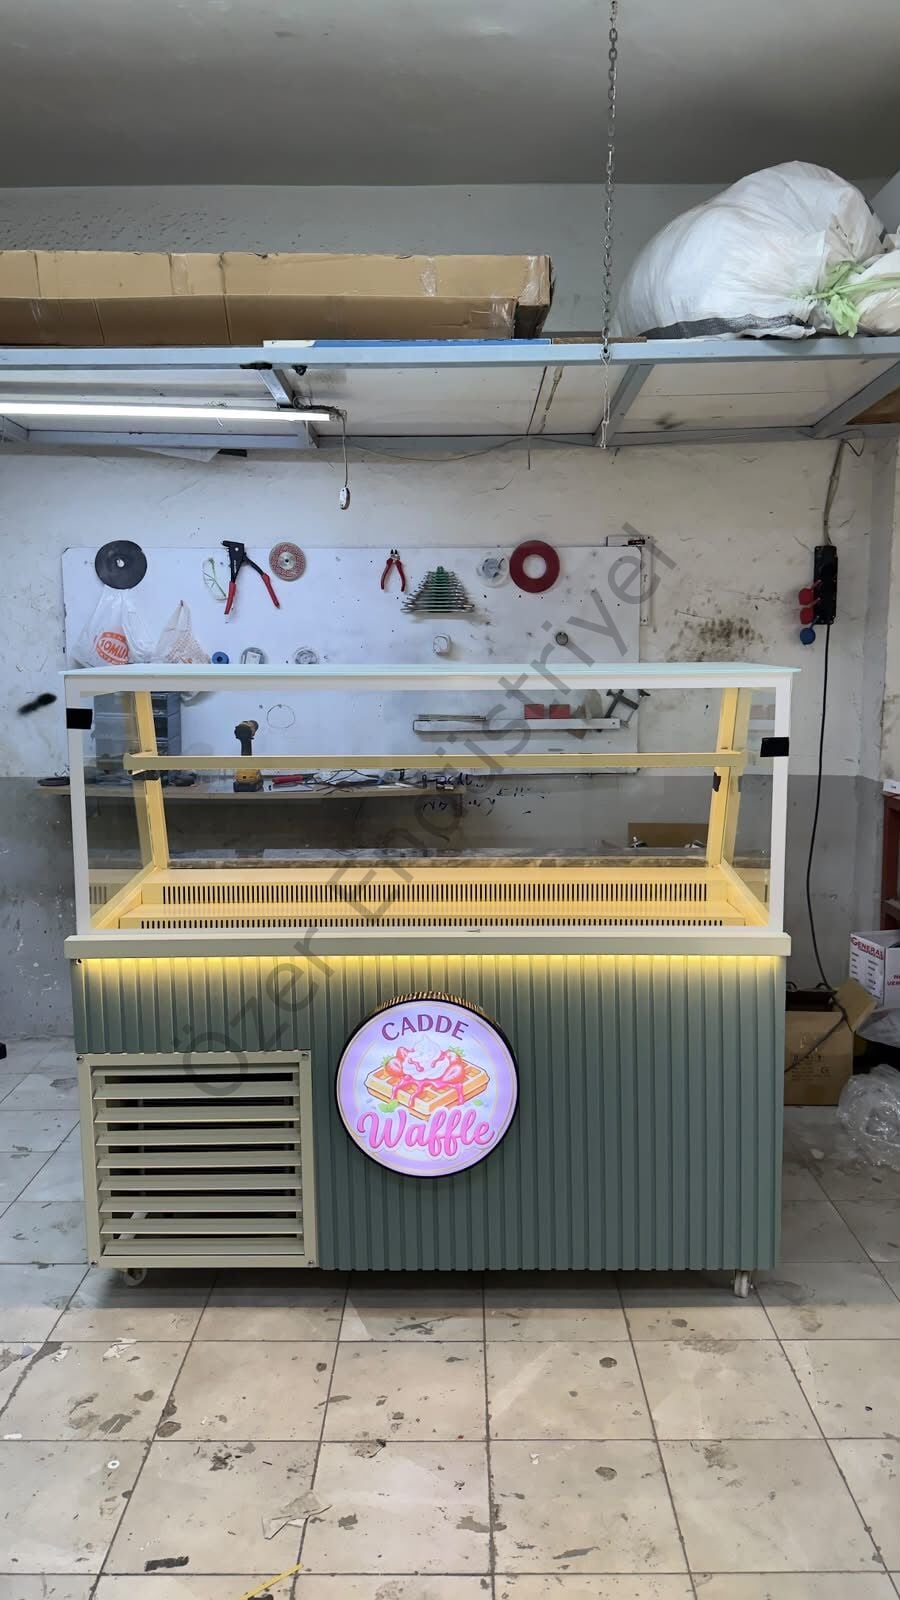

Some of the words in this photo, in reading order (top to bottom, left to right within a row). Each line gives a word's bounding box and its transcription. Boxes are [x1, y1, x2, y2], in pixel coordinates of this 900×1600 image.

[850, 936, 884, 960] GENERAL
[381, 1014, 469, 1041] CADDE
[356, 1108, 495, 1157] Waffle
